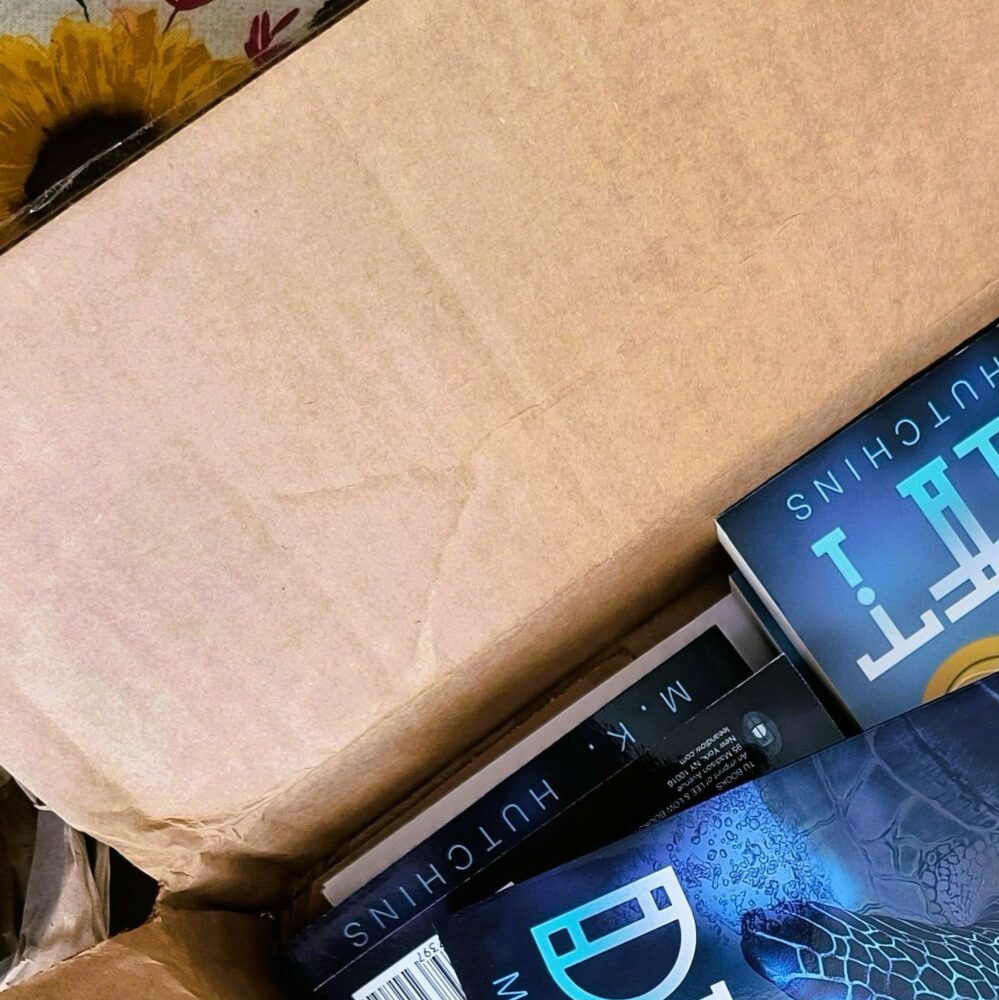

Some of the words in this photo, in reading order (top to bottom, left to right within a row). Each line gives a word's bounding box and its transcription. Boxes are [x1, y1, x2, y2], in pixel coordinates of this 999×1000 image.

[679, 726, 731, 765] leeandlow.com
[719, 735, 737, 748] New
[731, 743, 743, 754] 95
[690, 760, 702, 771] NY
[703, 750, 733, 773] Madison
[667, 770, 689, 788] 10016
[677, 771, 703, 792] Avenue
[690, 781, 706, 796] LEE
[716, 768, 743, 791] BOOKS
[666, 794, 686, 813] LOW
[343, 778, 559, 947] HUTCHINS
